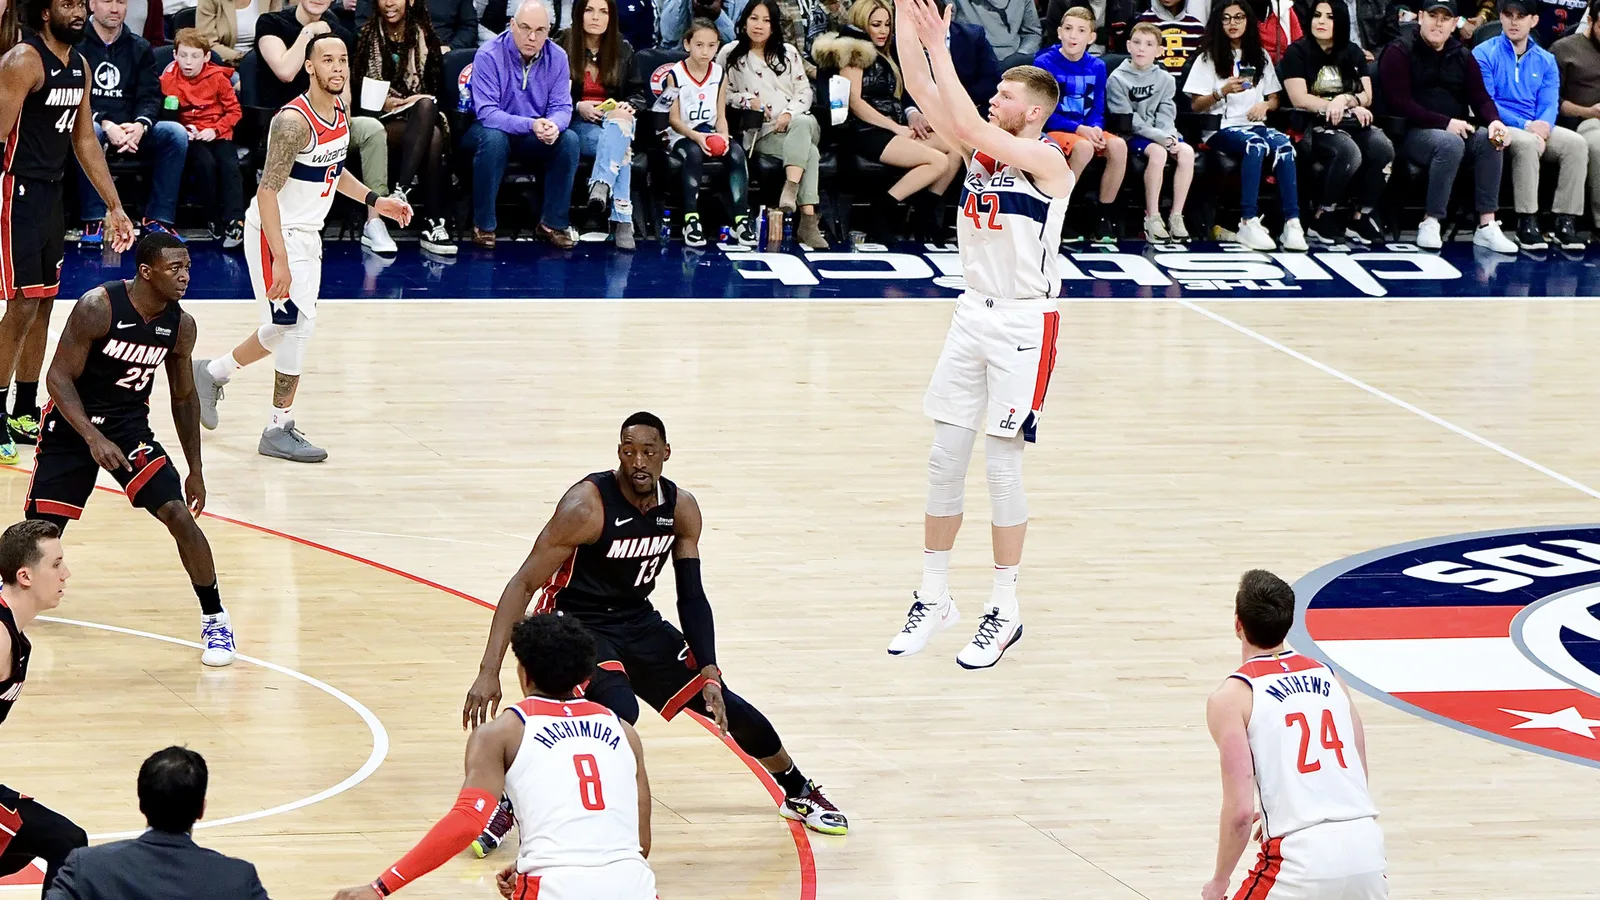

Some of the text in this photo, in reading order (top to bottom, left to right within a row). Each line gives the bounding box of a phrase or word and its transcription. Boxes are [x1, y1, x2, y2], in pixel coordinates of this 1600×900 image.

[1552, 8, 1567, 33] 3
[45, 88, 84, 106] MIAM
[1132, 84, 1155, 96] NIKE
[55, 109, 78, 133] 44
[689, 101, 711, 121] dc
[321, 165, 336, 197] 5
[964, 193, 1003, 231] 42
[1180, 279, 1302, 291] THE
[102, 339, 168, 366] MIAMI
[115, 367, 155, 391] 25
[999, 413, 1017, 430] dc
[606, 535, 675, 558] MIAMI
[634, 557, 660, 587] 13
[1265, 675, 1331, 703] MATHEWS
[533, 720, 620, 750] HACHIMURA
[1285, 709, 1348, 774] 24
[573, 754, 605, 811] 8
